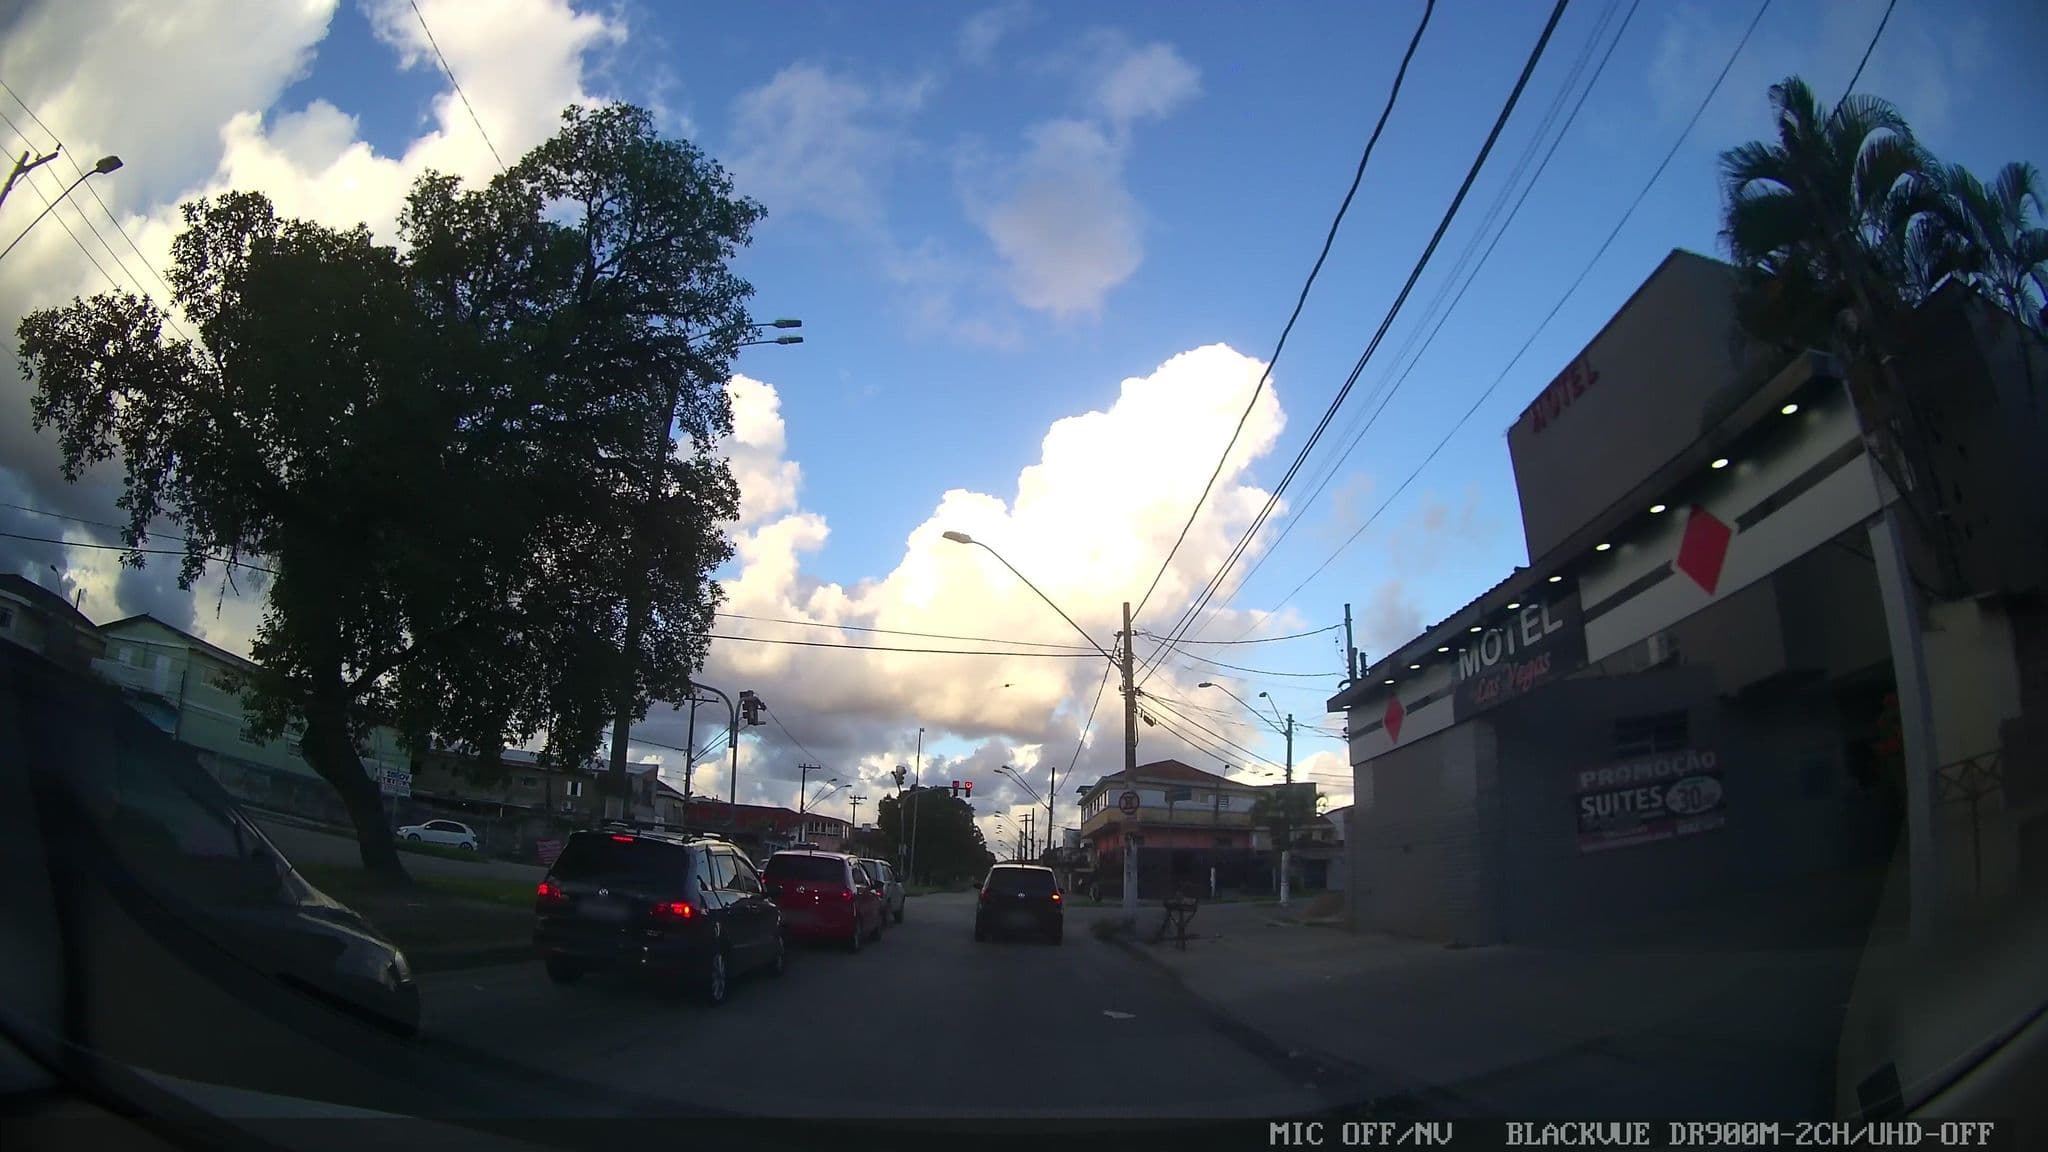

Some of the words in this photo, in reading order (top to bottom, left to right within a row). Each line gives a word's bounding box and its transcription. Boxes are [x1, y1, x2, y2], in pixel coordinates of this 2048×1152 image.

[1529, 353, 1600, 433] MOTEL
[1458, 601, 1563, 680] MOTEL
[1579, 749, 1716, 789] PROMOÇÃO
[1581, 785, 1663, 818] SUITES
